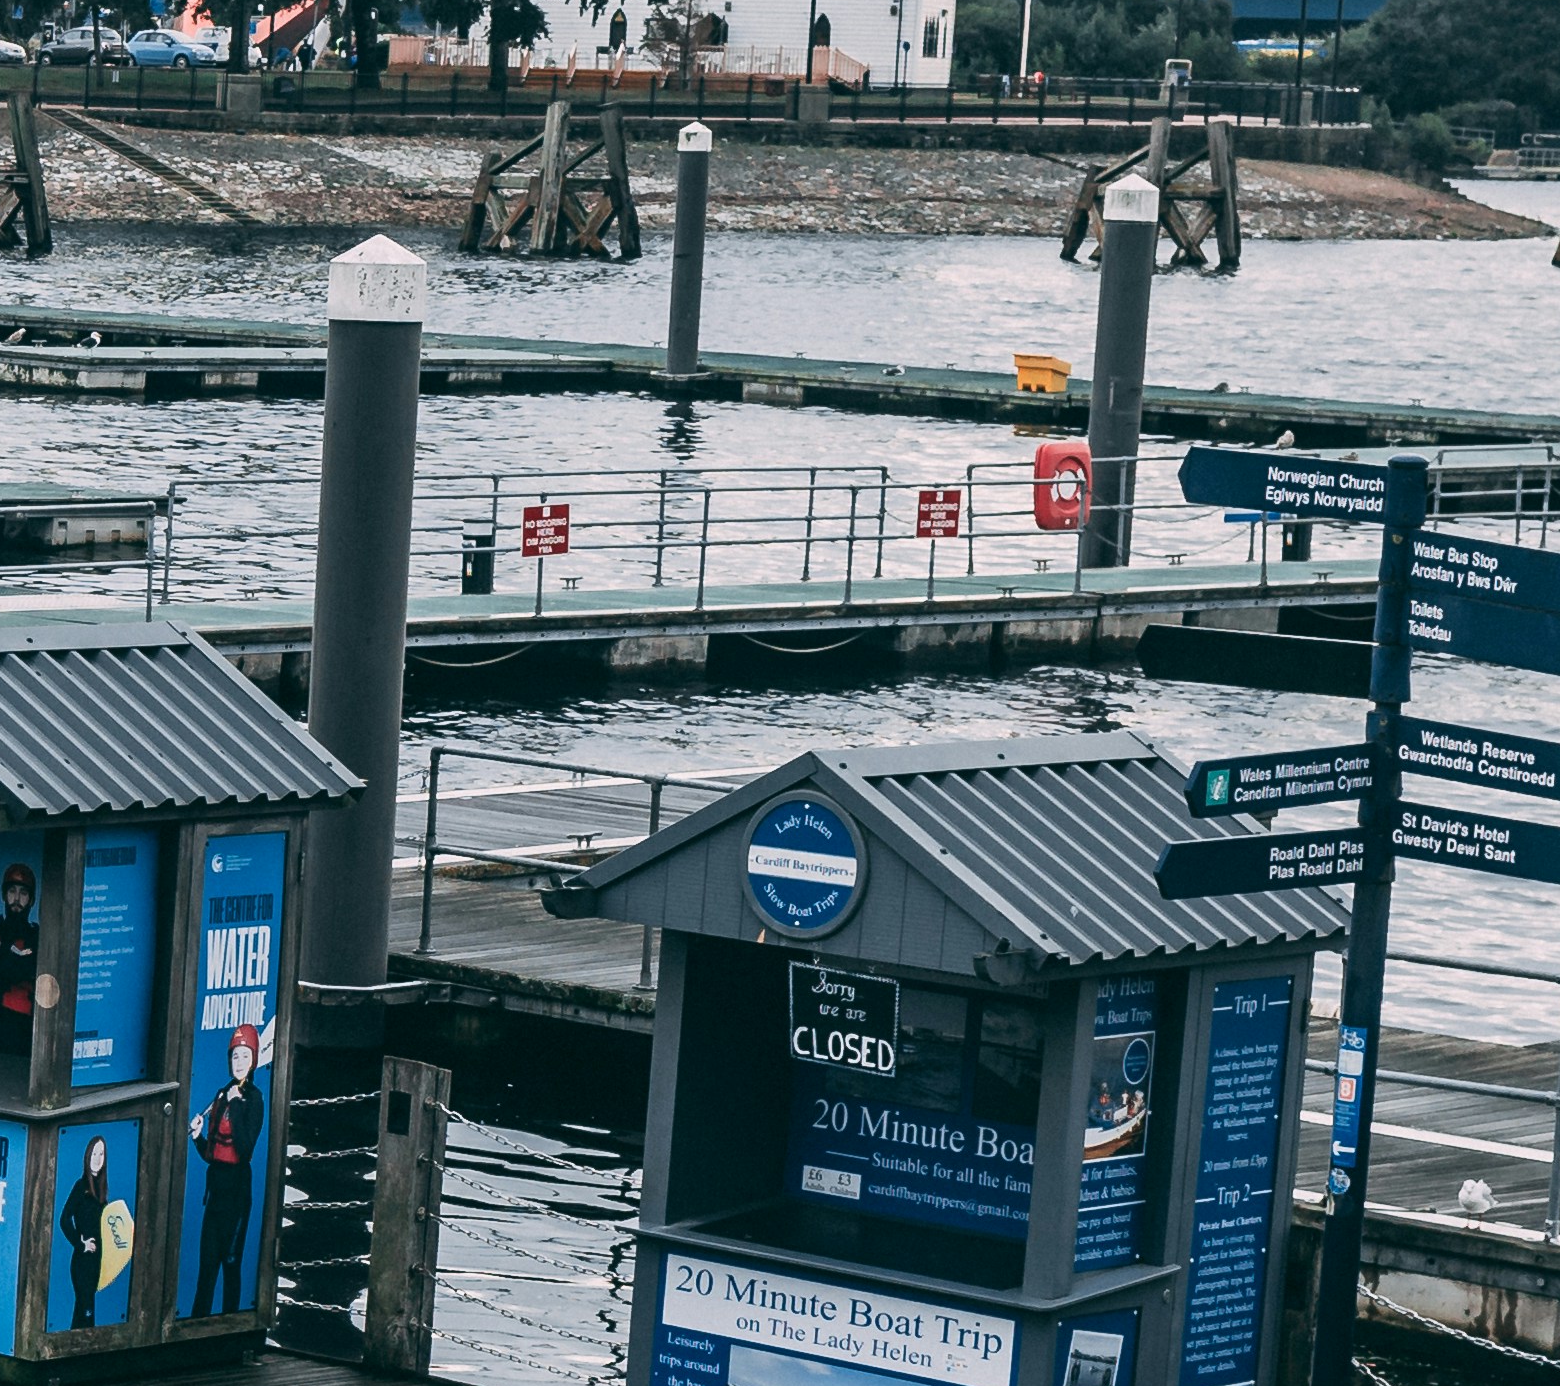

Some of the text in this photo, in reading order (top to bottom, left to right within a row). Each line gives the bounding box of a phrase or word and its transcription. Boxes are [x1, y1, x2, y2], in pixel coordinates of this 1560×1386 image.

[1267, 466, 1385, 492] Norwegian Church
[1265, 485, 1384, 513] Eglwys Norwyaidd
[1413, 541, 1498, 573] Water Bus Stop
[1410, 561, 1455, 583] Arosfan
[1456, 572, 1465, 588] y
[1467, 570, 1491, 589] Bws
[1410, 599, 1444, 621] Toilets
[1407, 619, 1452, 642] Toiledau
[1421, 729, 1536, 766] Wetlands Reserve
[1240, 757, 1370, 783] Wales Millennium Centre
[1398, 744, 1556, 788] Gwarchodfa Corstiroedd
[1234, 774, 1373, 802] Canolfan Mileniwm Cymru
[774, 814, 833, 840] Lady Helen
[1401, 812, 1510, 845] St David's Hotel
[1270, 840, 1364, 862] Roald Dahl Plas
[1392, 829, 1516, 864] Gwesty Dewi Sant
[1269, 857, 1364, 880] Plas Roald Dahl
[763, 882, 839, 916] Slow Boat Trips
[206, 925, 271, 990] WATER
[811, 971, 856, 1002] Sorry
[201, 990, 267, 1031] ADVENTURE
[819, 1003, 867, 1022] we are
[793, 1026, 895, 1071] CLOSED
[812, 1098, 1034, 1165] 20 Minute Boa
[871, 1151, 1031, 1194] Suitable for all the fam
[1217, 1183, 1251, 1209] Trip 2
[675, 1265, 1003, 1361] 20 Minute Boat Trip
[667, 1331, 715, 1354] Leisurely
[735, 1315, 761, 1333] on
[768, 1317, 807, 1343] The
[813, 1327, 865, 1357] Lady
[871, 1338, 933, 1368] Helen
[659, 1353, 720, 1375] trips around
